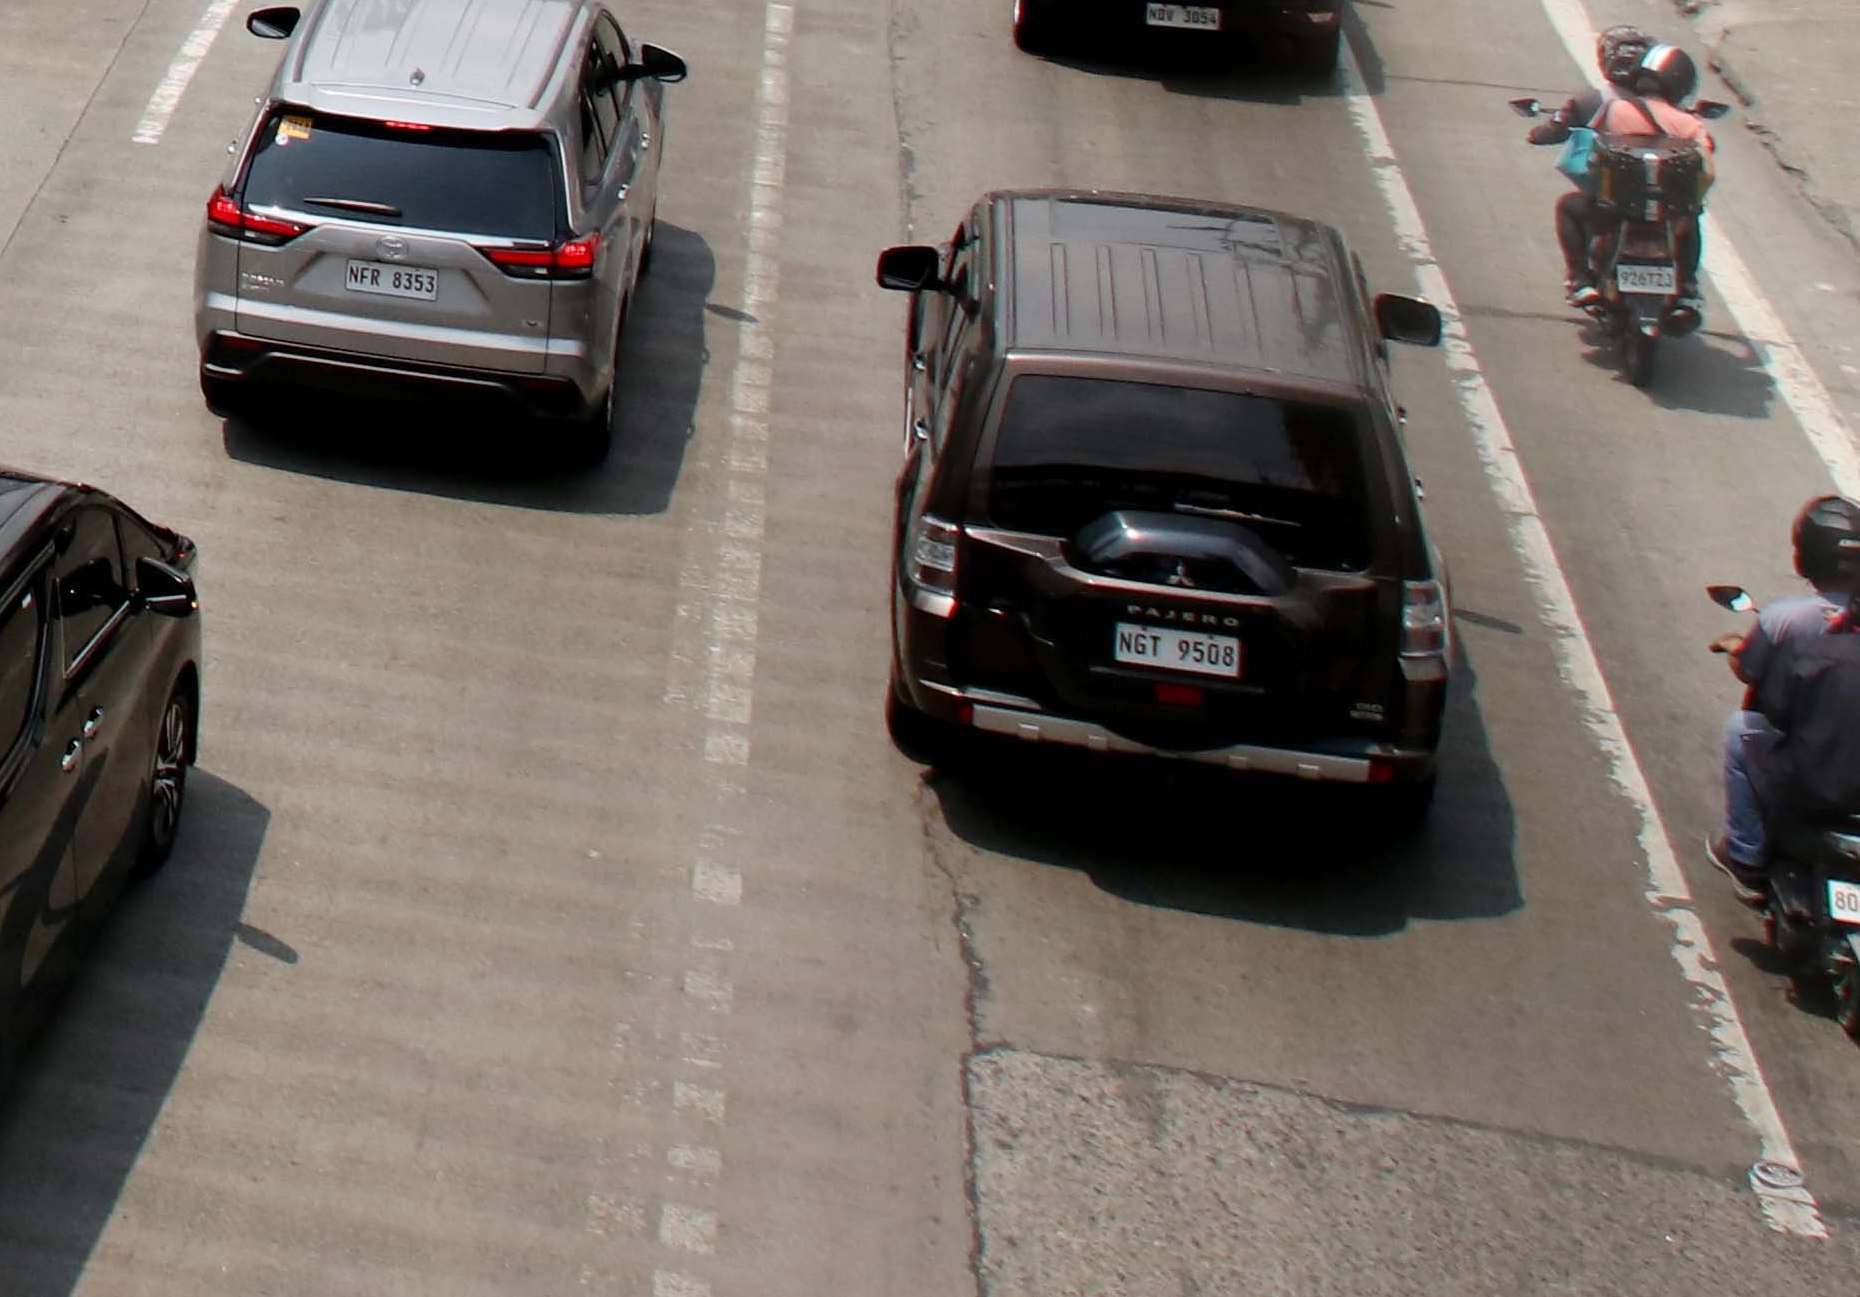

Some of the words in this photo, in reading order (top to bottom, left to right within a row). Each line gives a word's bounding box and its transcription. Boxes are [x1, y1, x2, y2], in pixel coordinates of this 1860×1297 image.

[348, 265, 379, 287] NFR
[392, 271, 436, 293] 8353
[1127, 605, 1240, 627] PAJERO
[1118, 629, 1160, 658] NGT
[1177, 639, 1235, 667] 9508
